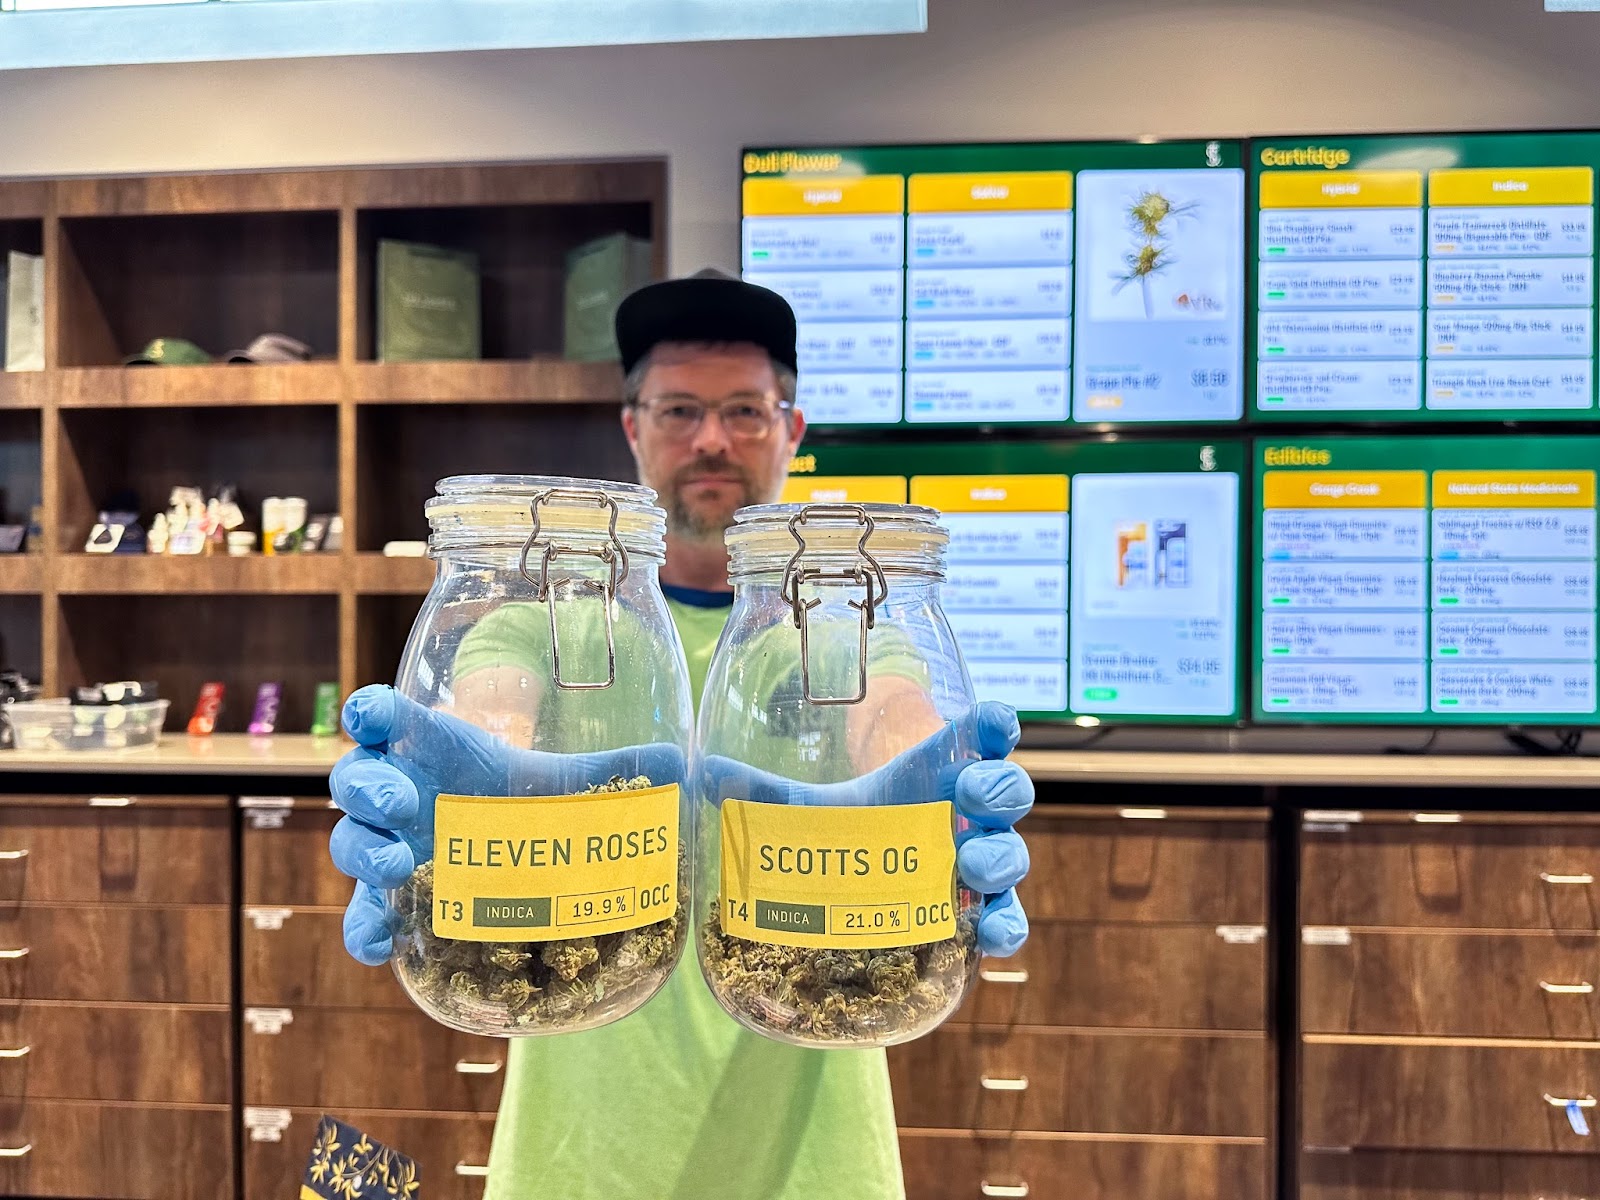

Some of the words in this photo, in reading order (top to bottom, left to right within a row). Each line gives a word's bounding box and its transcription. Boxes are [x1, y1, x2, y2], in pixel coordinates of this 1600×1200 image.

[1261, 146, 1350, 169] Cartridge
[1264, 447, 1331, 466] Edibles
[1448, 483, 1489, 495] Natural
[448, 837, 571, 867] ELEVEN
[586, 826, 668, 863] ROSES
[760, 844, 870, 876] SCOTTS
[883, 846, 918, 874] OG
[439, 899, 464, 921] T3
[486, 906, 534, 919] INDICA
[572, 895, 626, 918] 19.9%
[640, 883, 670, 909] OCC
[728, 899, 749, 921] T4
[767, 909, 810, 925] INDICA
[915, 902, 950, 926] OCC
